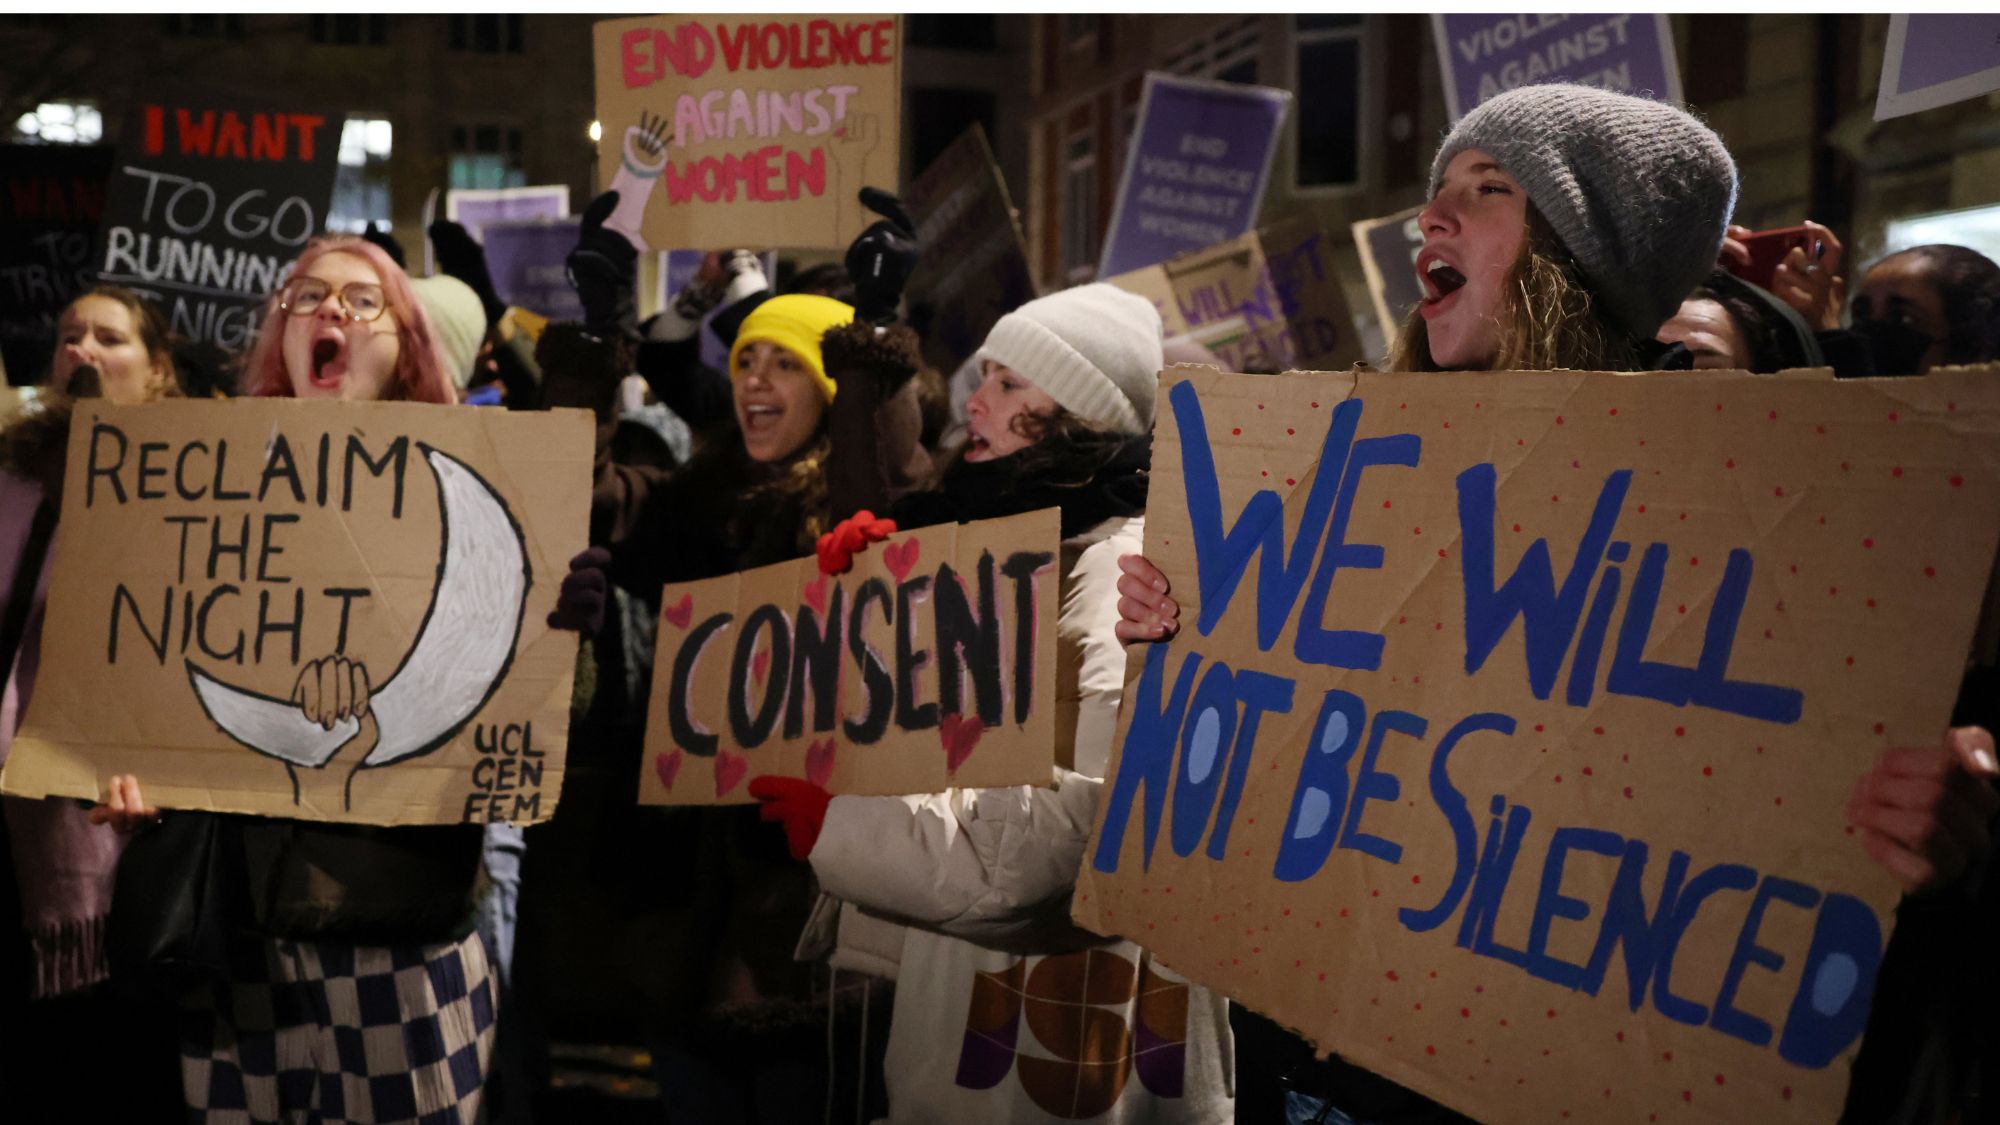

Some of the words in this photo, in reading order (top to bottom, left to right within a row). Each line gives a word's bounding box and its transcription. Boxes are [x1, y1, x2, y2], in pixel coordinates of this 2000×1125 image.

[621, 22, 716, 88] END
[717, 20, 894, 71] VIOLENCE
[1458, 14, 1571, 63] VIOLE
[1476, 14, 1631, 101] AGAINST
[145, 105, 164, 156] I
[175, 108, 324, 161] WANT
[674, 85, 860, 146] AGAINST
[123, 165, 215, 234] TO
[224, 189, 314, 246] GO
[666, 145, 826, 205] WOMEN
[86, 417, 409, 518] RECLAIM
[164, 513, 300, 584] THE
[1169, 380, 1421, 671] WE
[107, 583, 371, 666] NIGHT
[668, 547, 1056, 757] CONSENT
[473, 721, 546, 759] UCL
[1093, 642, 1296, 873] NOT
[1273, 689, 1428, 882] BE
[463, 793, 540, 824] FEM
[471, 758, 543, 792] GEN
